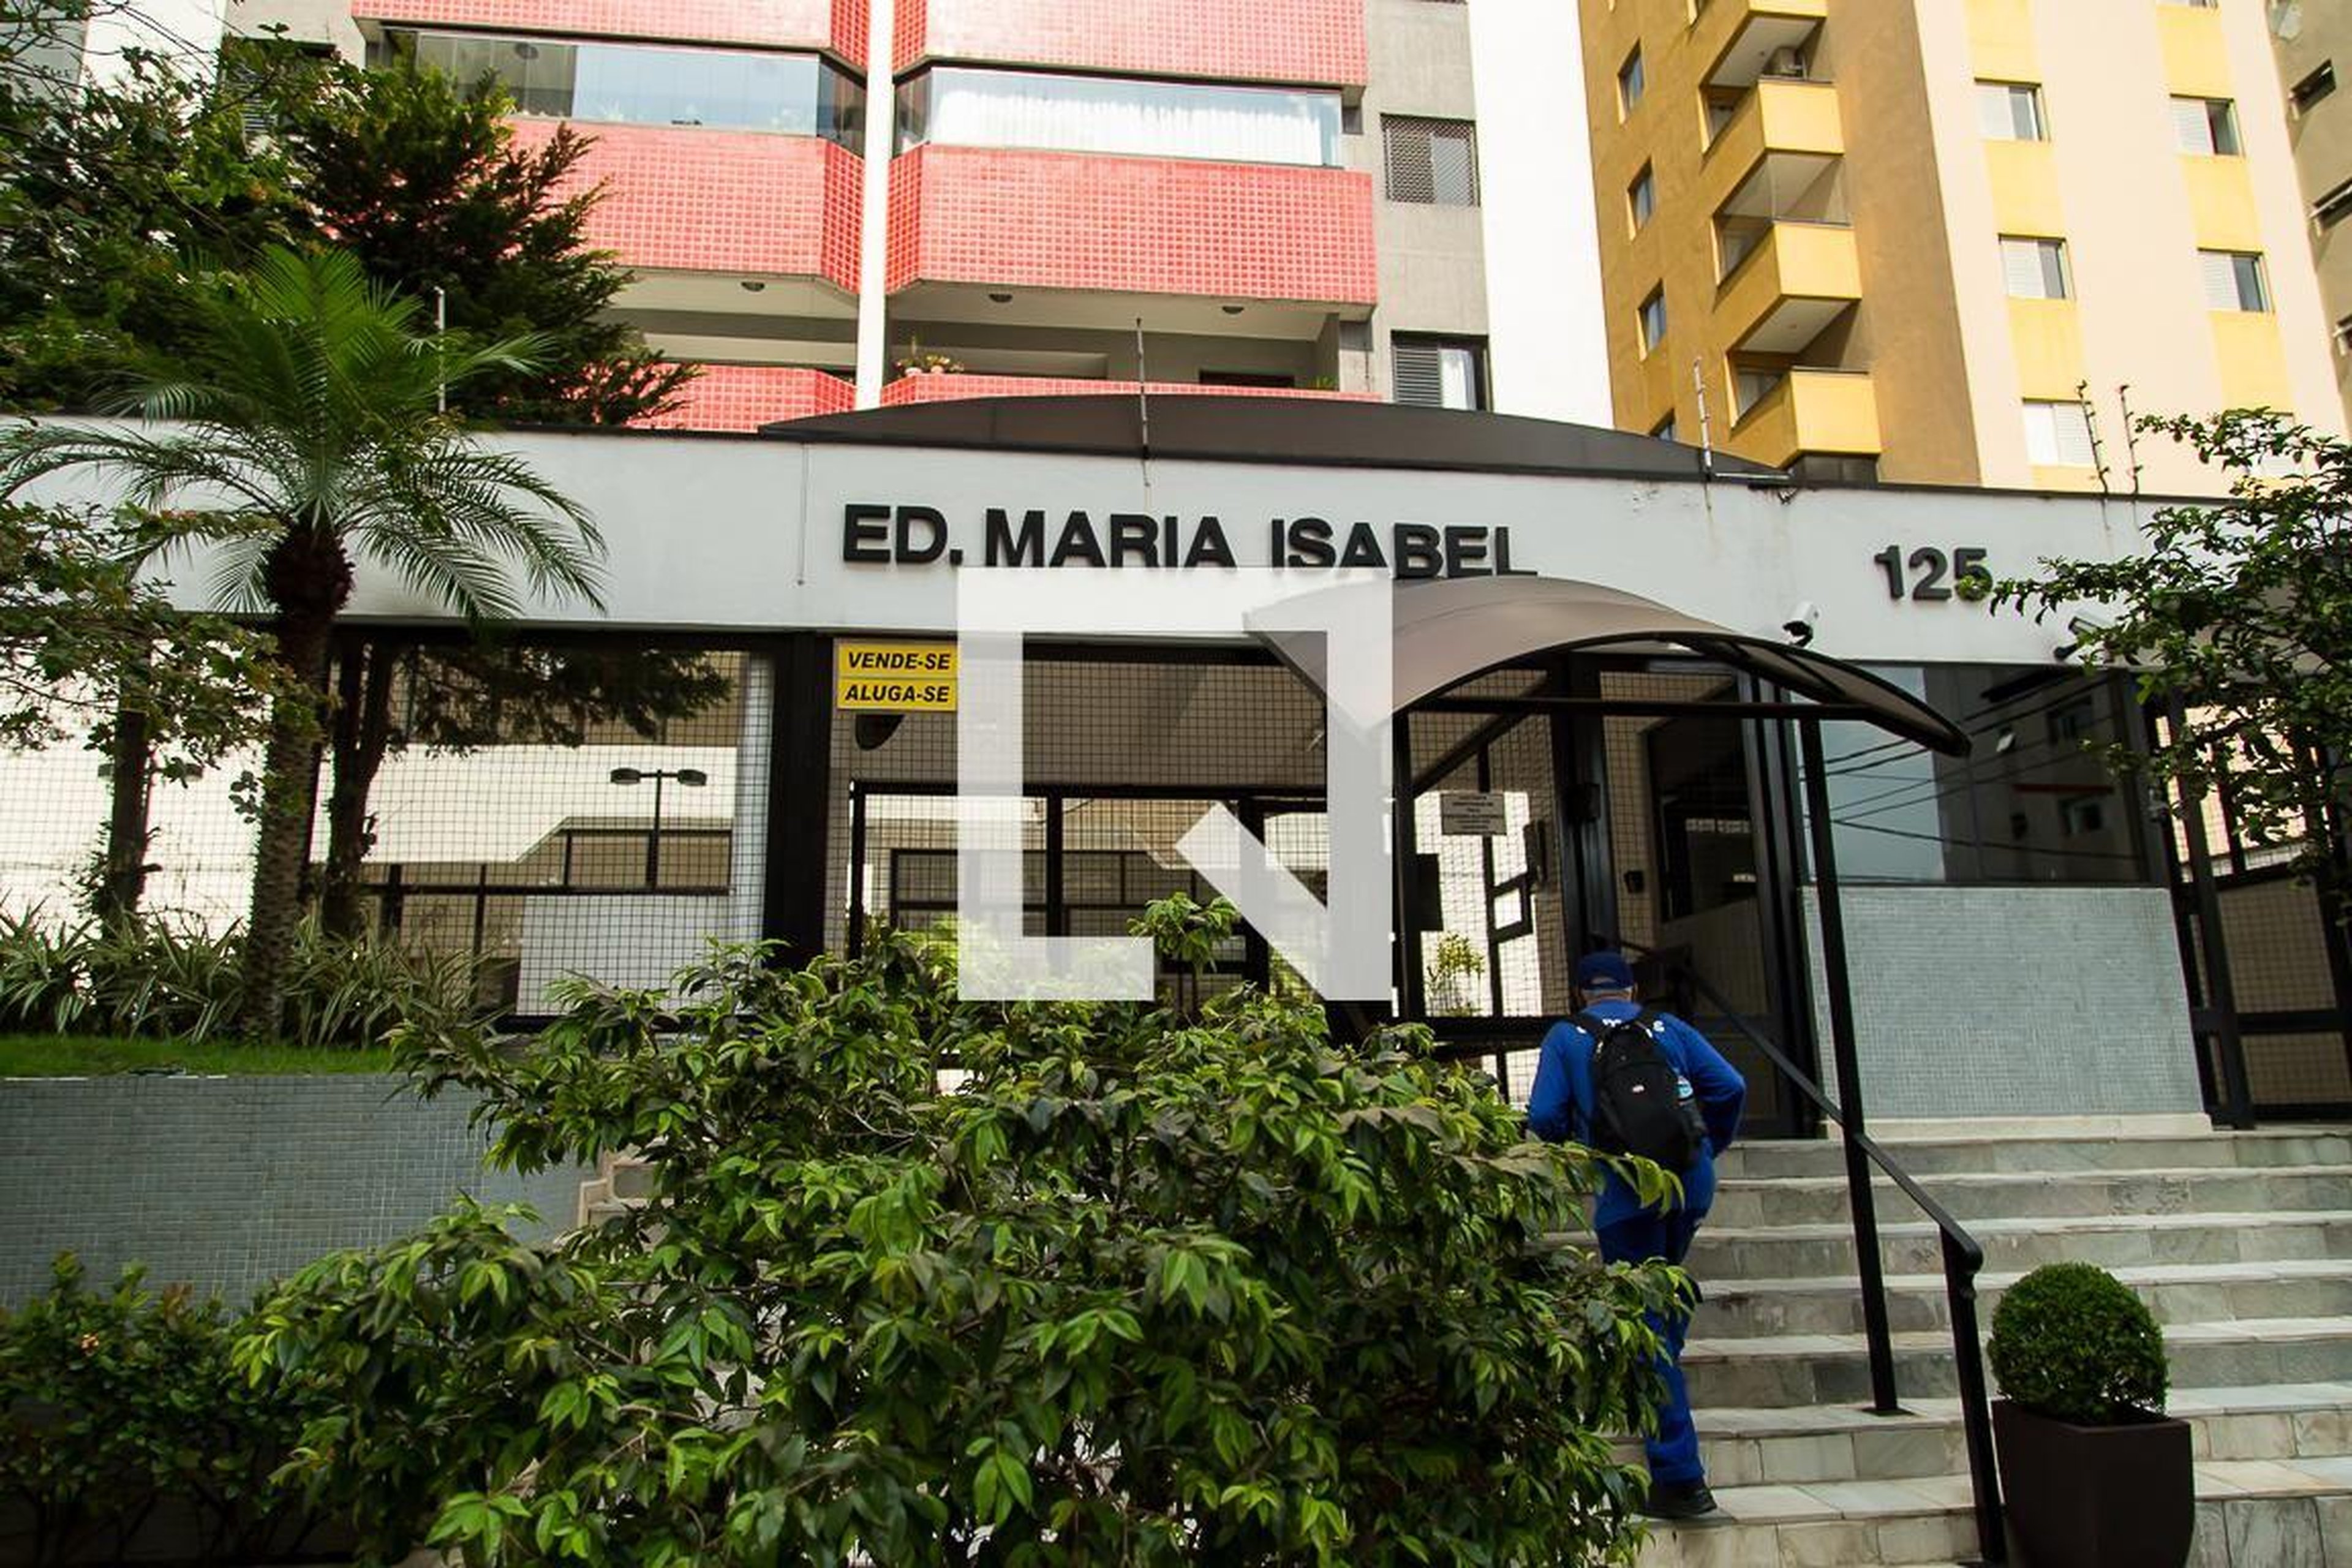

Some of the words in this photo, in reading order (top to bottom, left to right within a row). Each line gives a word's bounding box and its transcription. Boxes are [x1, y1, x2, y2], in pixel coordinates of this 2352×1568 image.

[843, 504, 963, 565] ED.
[985, 508, 1237, 568] MARIA
[1271, 518, 1538, 579] ISABEL
[1874, 545, 1993, 601] 125
[849, 652, 951, 670] VENDE-SE
[845, 685, 950, 702] ALUGA-SE
